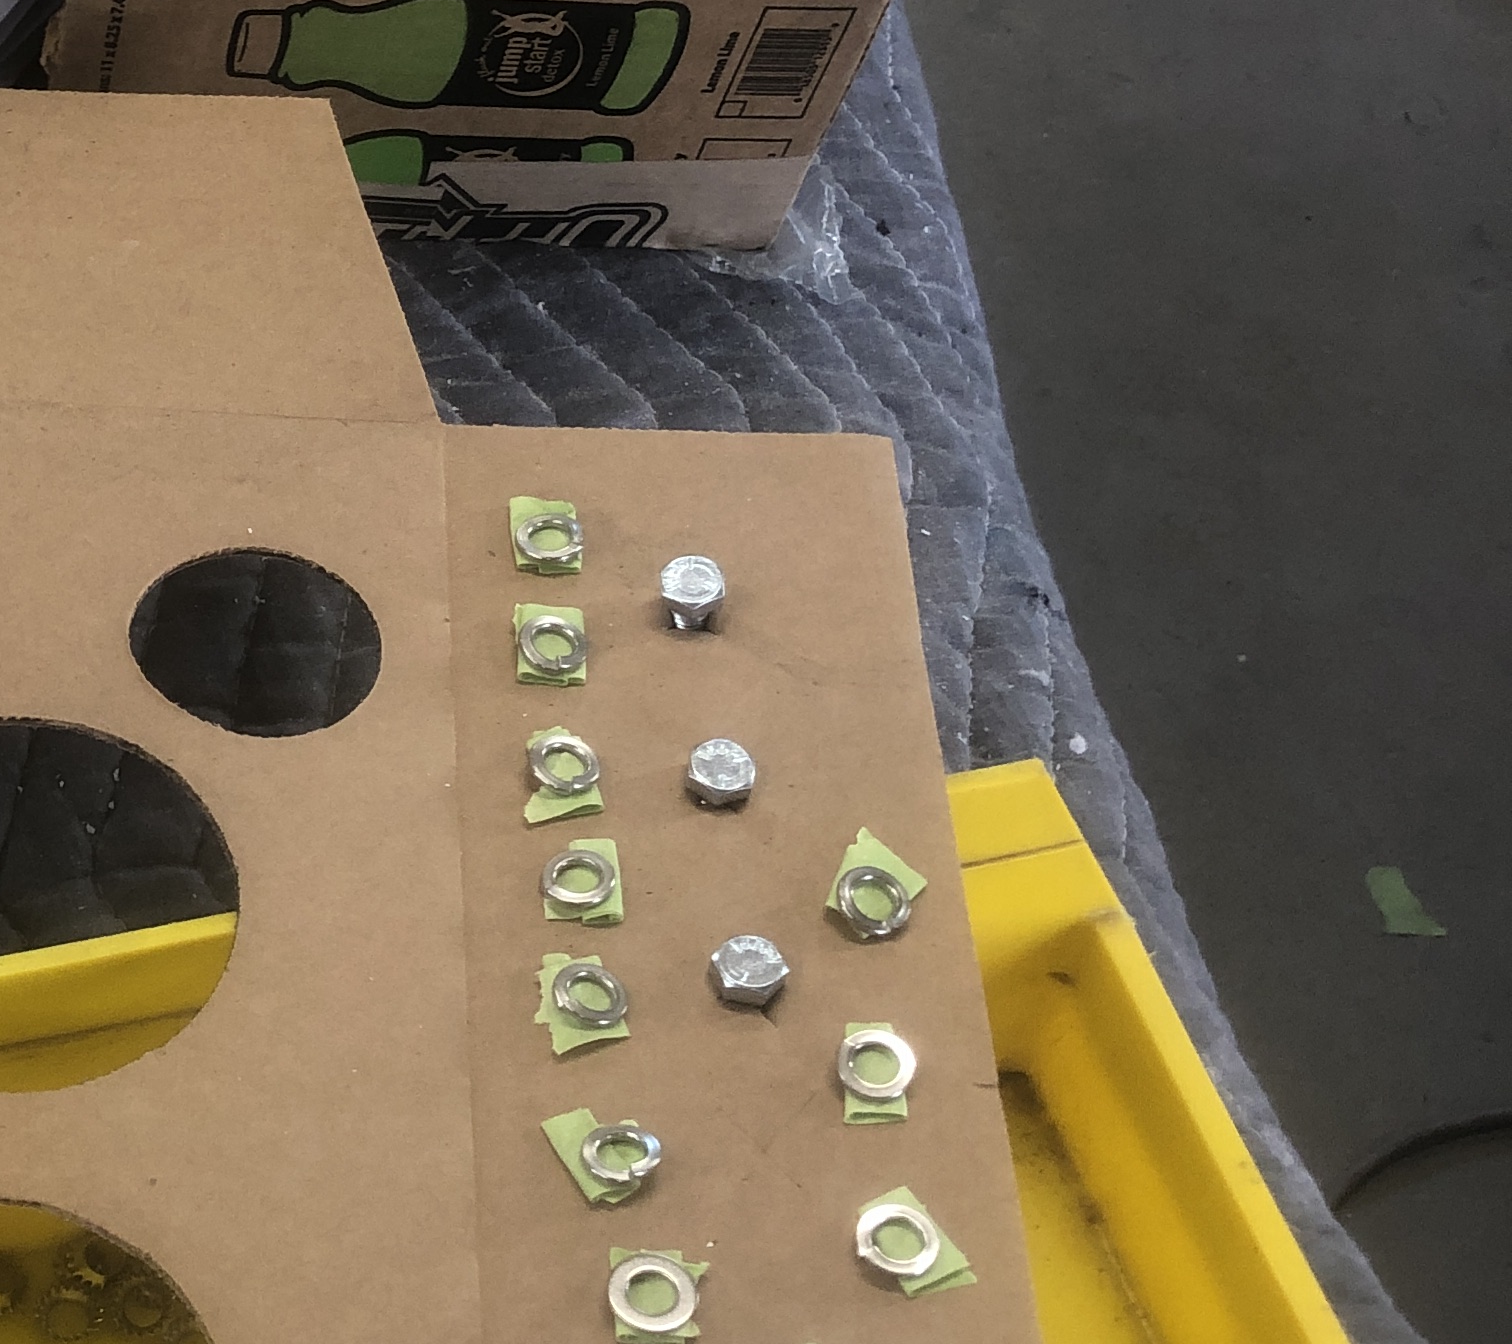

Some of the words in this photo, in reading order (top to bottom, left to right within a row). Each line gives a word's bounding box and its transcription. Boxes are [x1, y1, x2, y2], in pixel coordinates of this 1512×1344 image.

[487, 36, 532, 85] jump
[522, 37, 553, 74] start
[541, 48, 567, 83] detox
[585, 53, 611, 87] Lemon
[600, 27, 620, 53] Lime
[700, 58, 729, 93] Lemon
[716, 31, 741, 57] Lime
